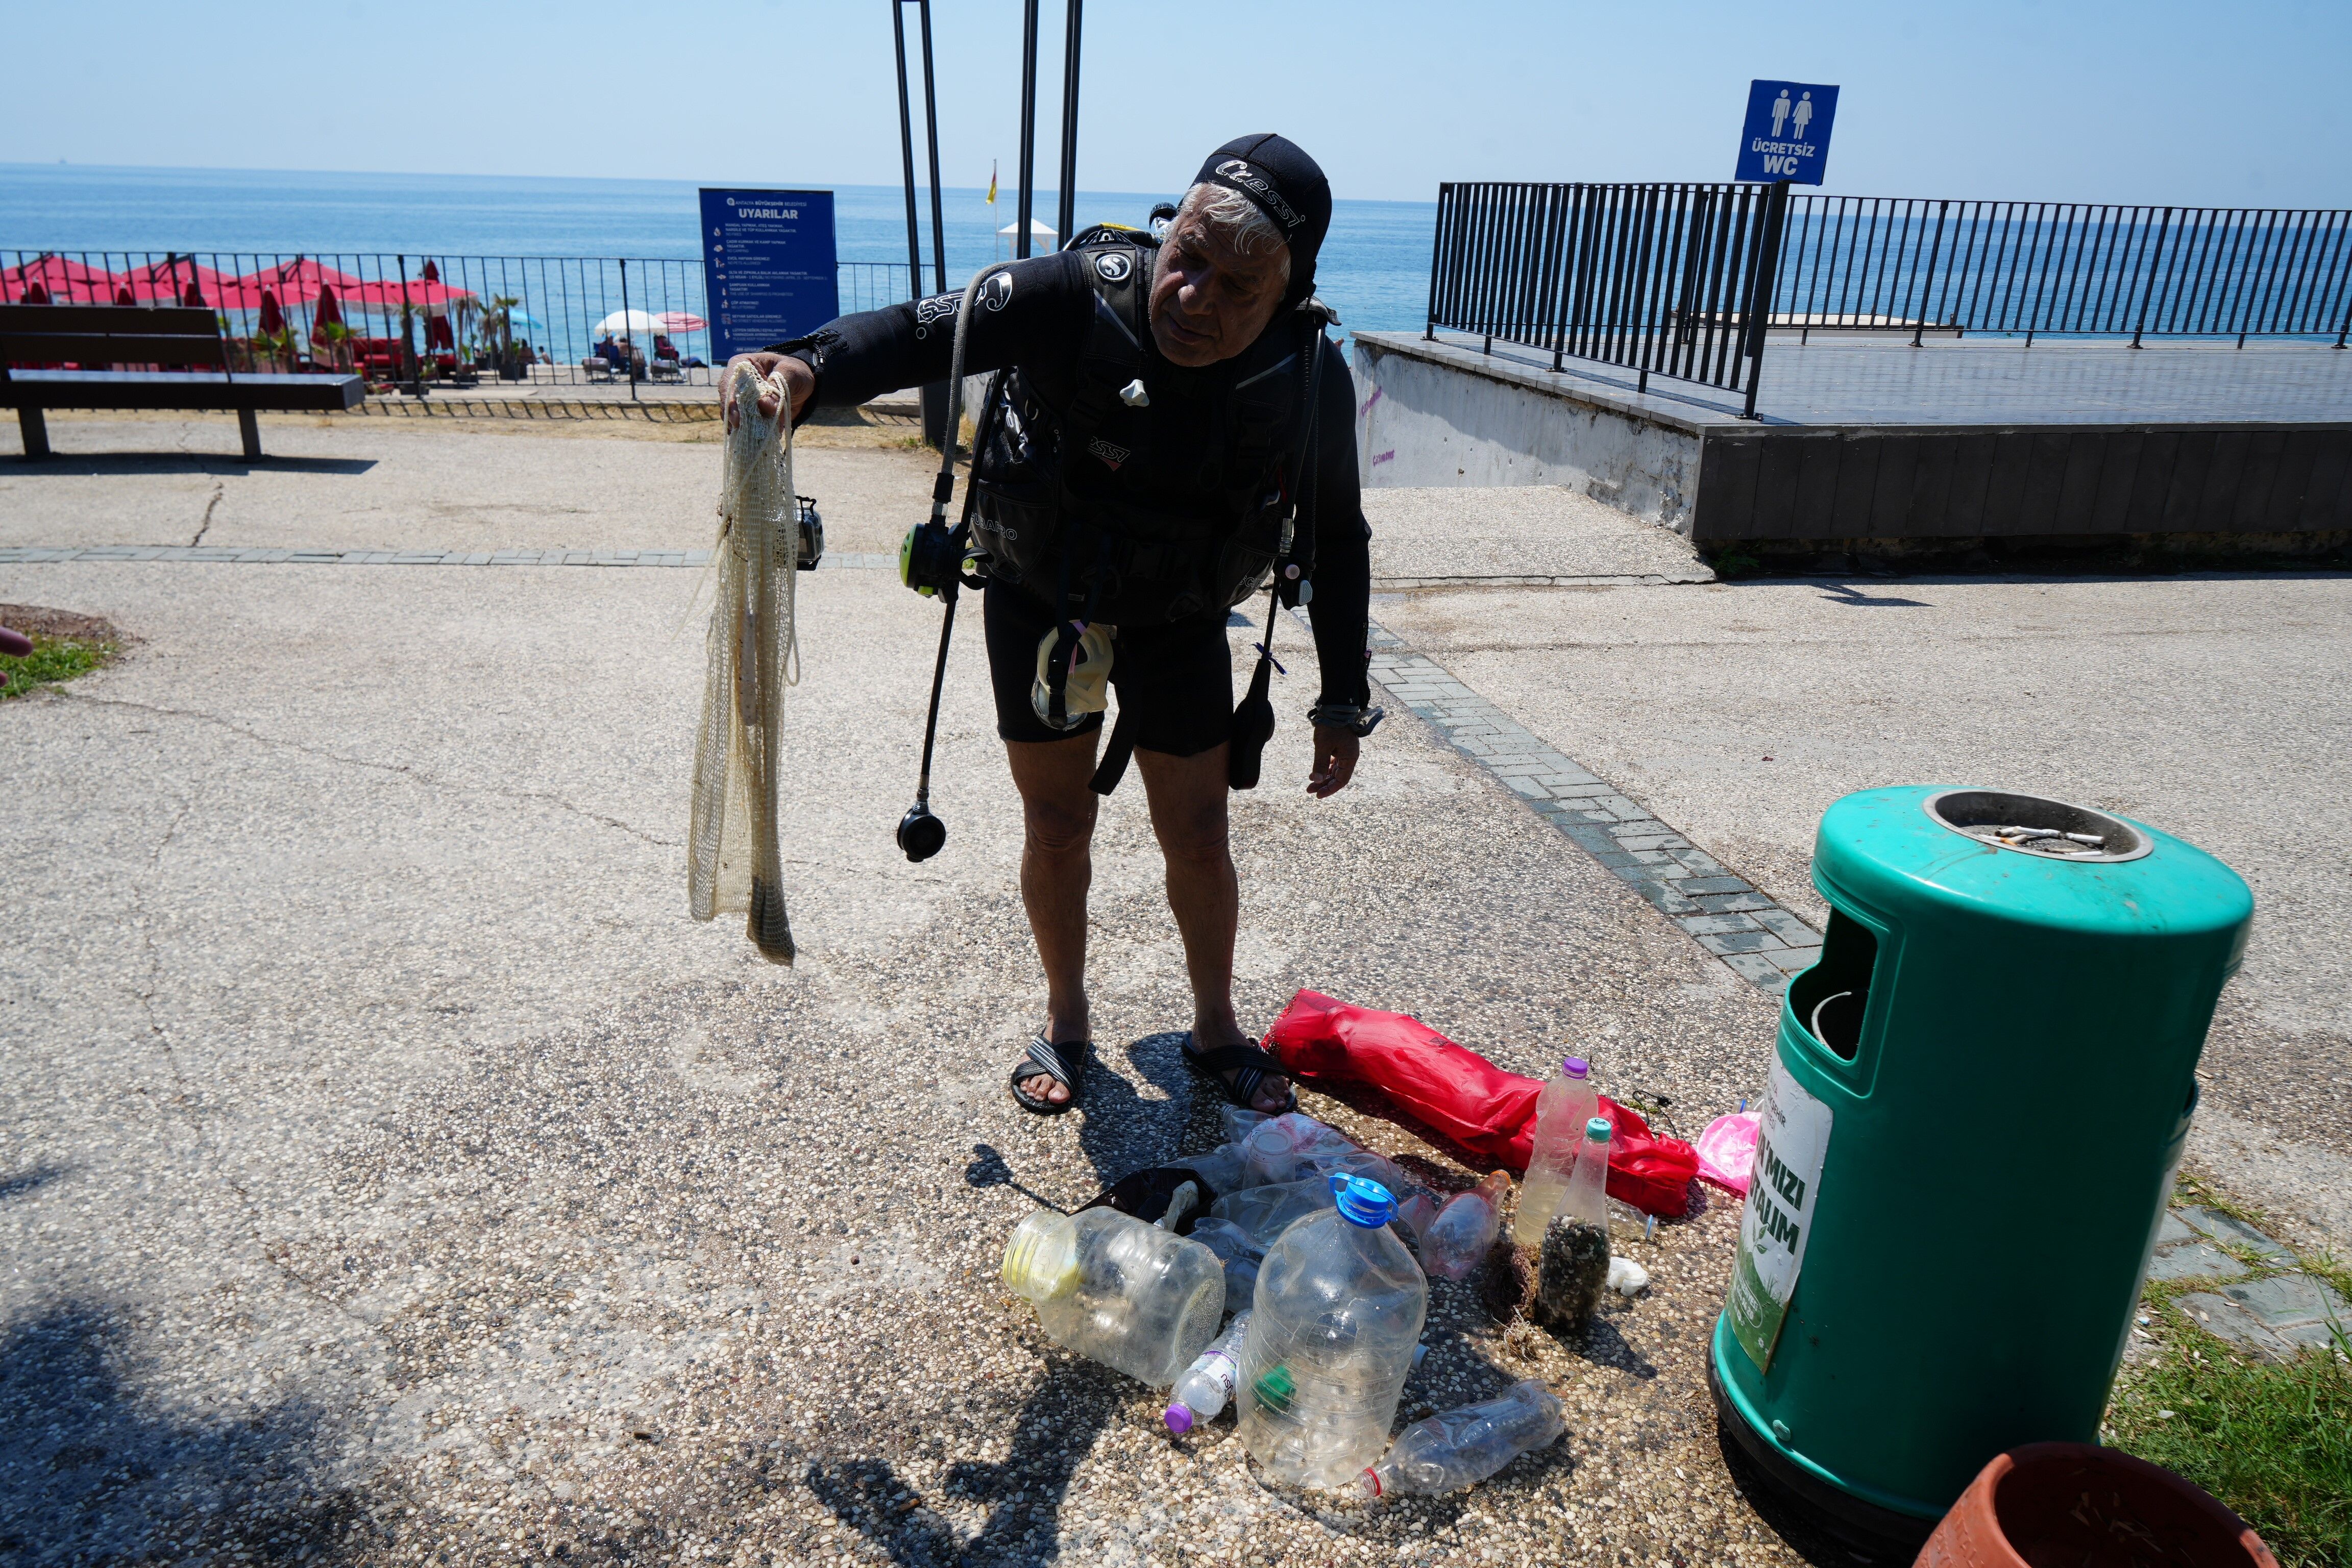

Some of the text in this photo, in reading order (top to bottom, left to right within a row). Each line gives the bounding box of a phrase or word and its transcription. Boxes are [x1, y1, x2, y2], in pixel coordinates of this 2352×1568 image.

[1752, 137, 1816, 157] ÜCRETSİZ
[1763, 154, 1798, 176] WC
[1215, 160, 1300, 228] Cressi
[739, 208, 798, 219] UYARILAR
